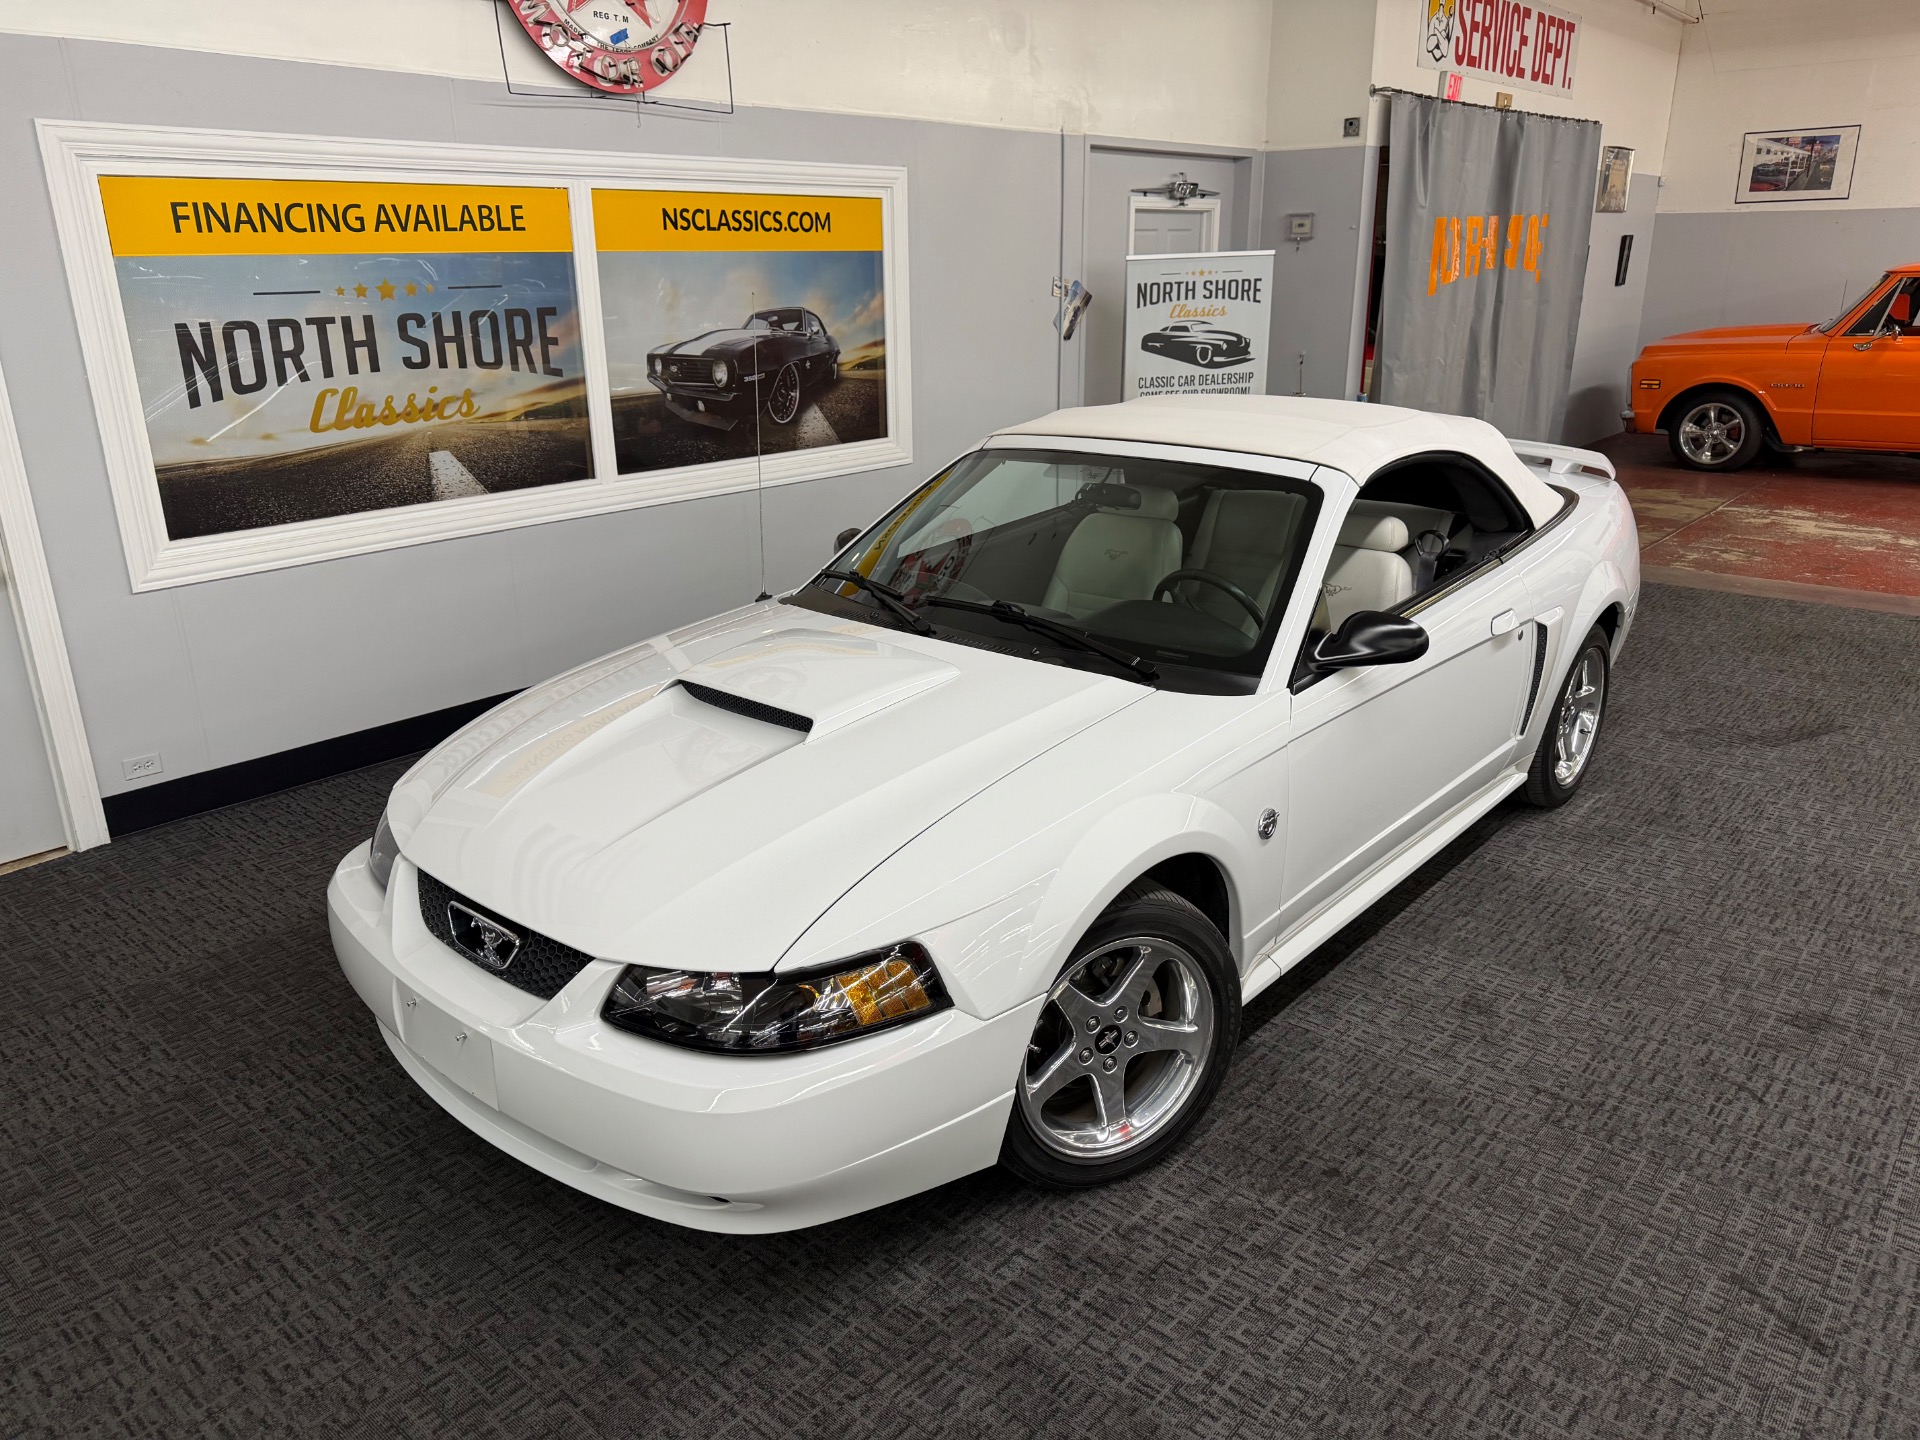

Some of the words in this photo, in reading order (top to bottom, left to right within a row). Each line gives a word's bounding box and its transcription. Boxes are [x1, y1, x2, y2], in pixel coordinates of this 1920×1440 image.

[1455, 0, 1531, 78] SERVICE
[1532, 12, 1575, 89] DEPT.
[170, 201, 366, 234] FINANCING
[374, 203, 526, 232] AVAILABLE
[662, 207, 831, 232] NSCLASSICS.COM
[1136, 280, 1196, 309] NORTH
[1202, 278, 1262, 303] SHORE
[1169, 303, 1228, 319] Classics
[174, 315, 381, 409] NORTH
[396, 306, 564, 378] SHORE
[1138, 376, 1175, 389] CLASSIC
[1177, 374, 1196, 387] CAR
[1198, 371, 1254, 386] DEALERSHIP
[309, 386, 481, 433] Classics
